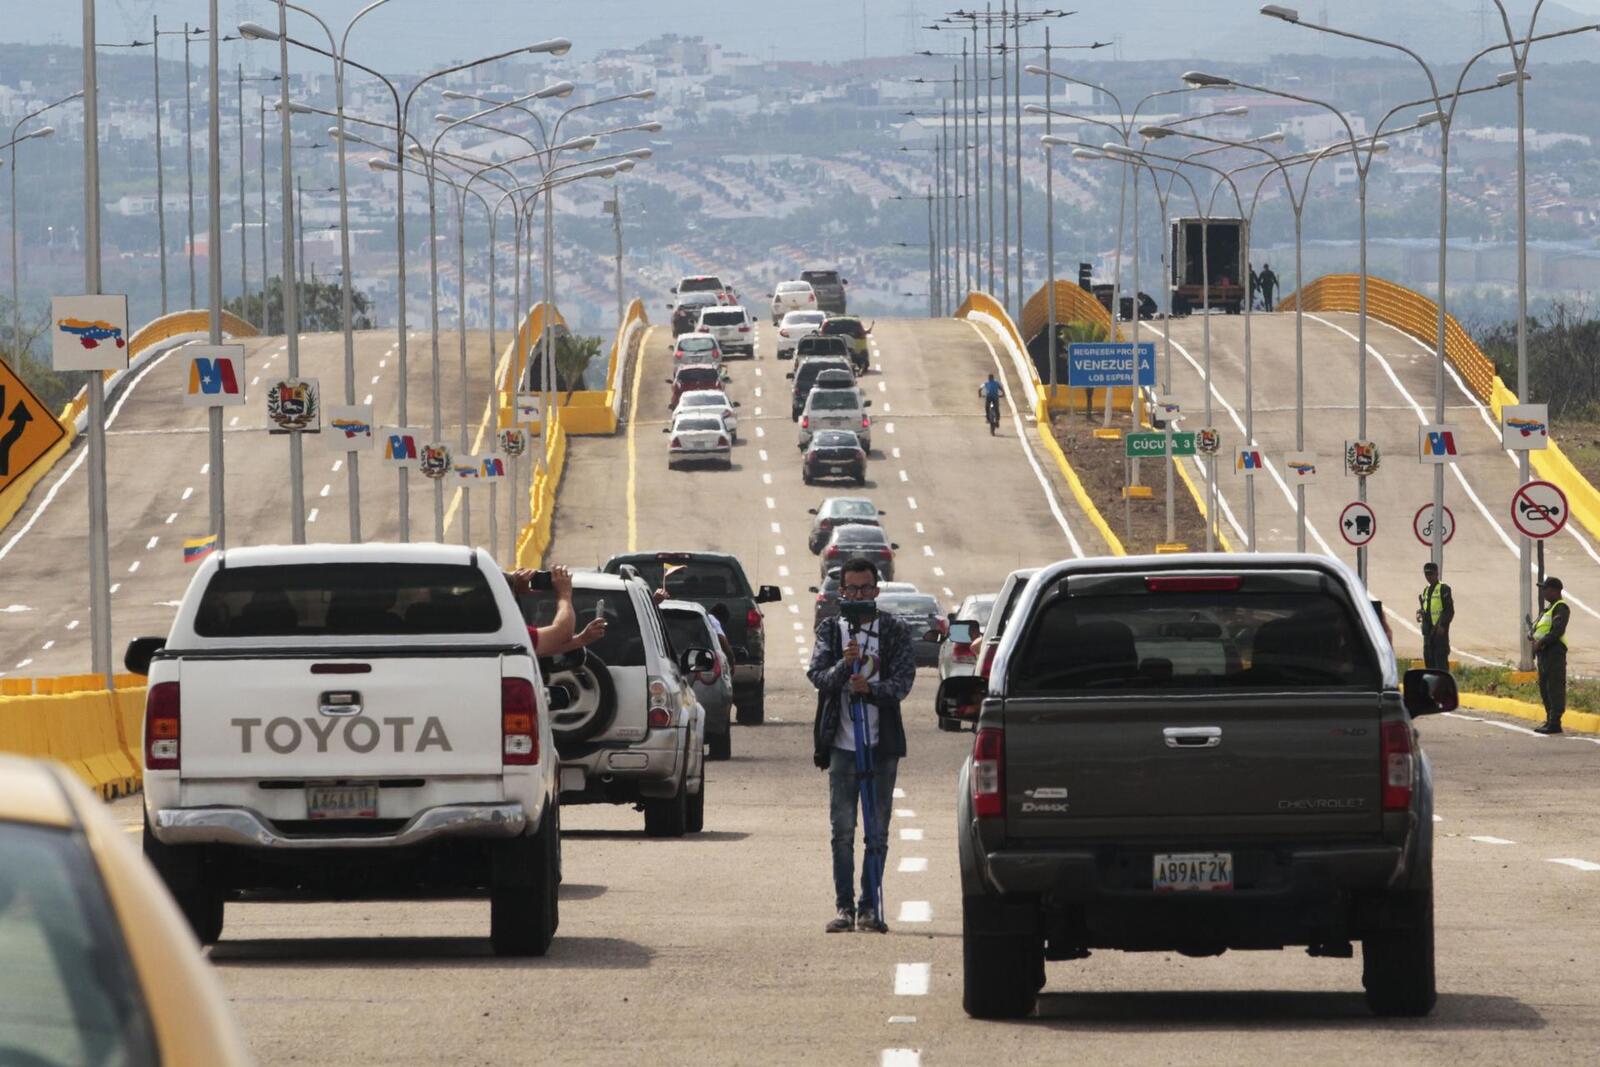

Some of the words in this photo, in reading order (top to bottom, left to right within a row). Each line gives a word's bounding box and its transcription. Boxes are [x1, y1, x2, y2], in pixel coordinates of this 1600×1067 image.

[1075, 360, 1150, 370] VENEZUEA
[1088, 374, 1104, 382] LOS
[1133, 438, 1178, 450] CÚCUA
[230, 716, 454, 754] TOYOTA
[1278, 798, 1366, 809] CHEVROLET
[1160, 861, 1229, 882] A89AF2K
